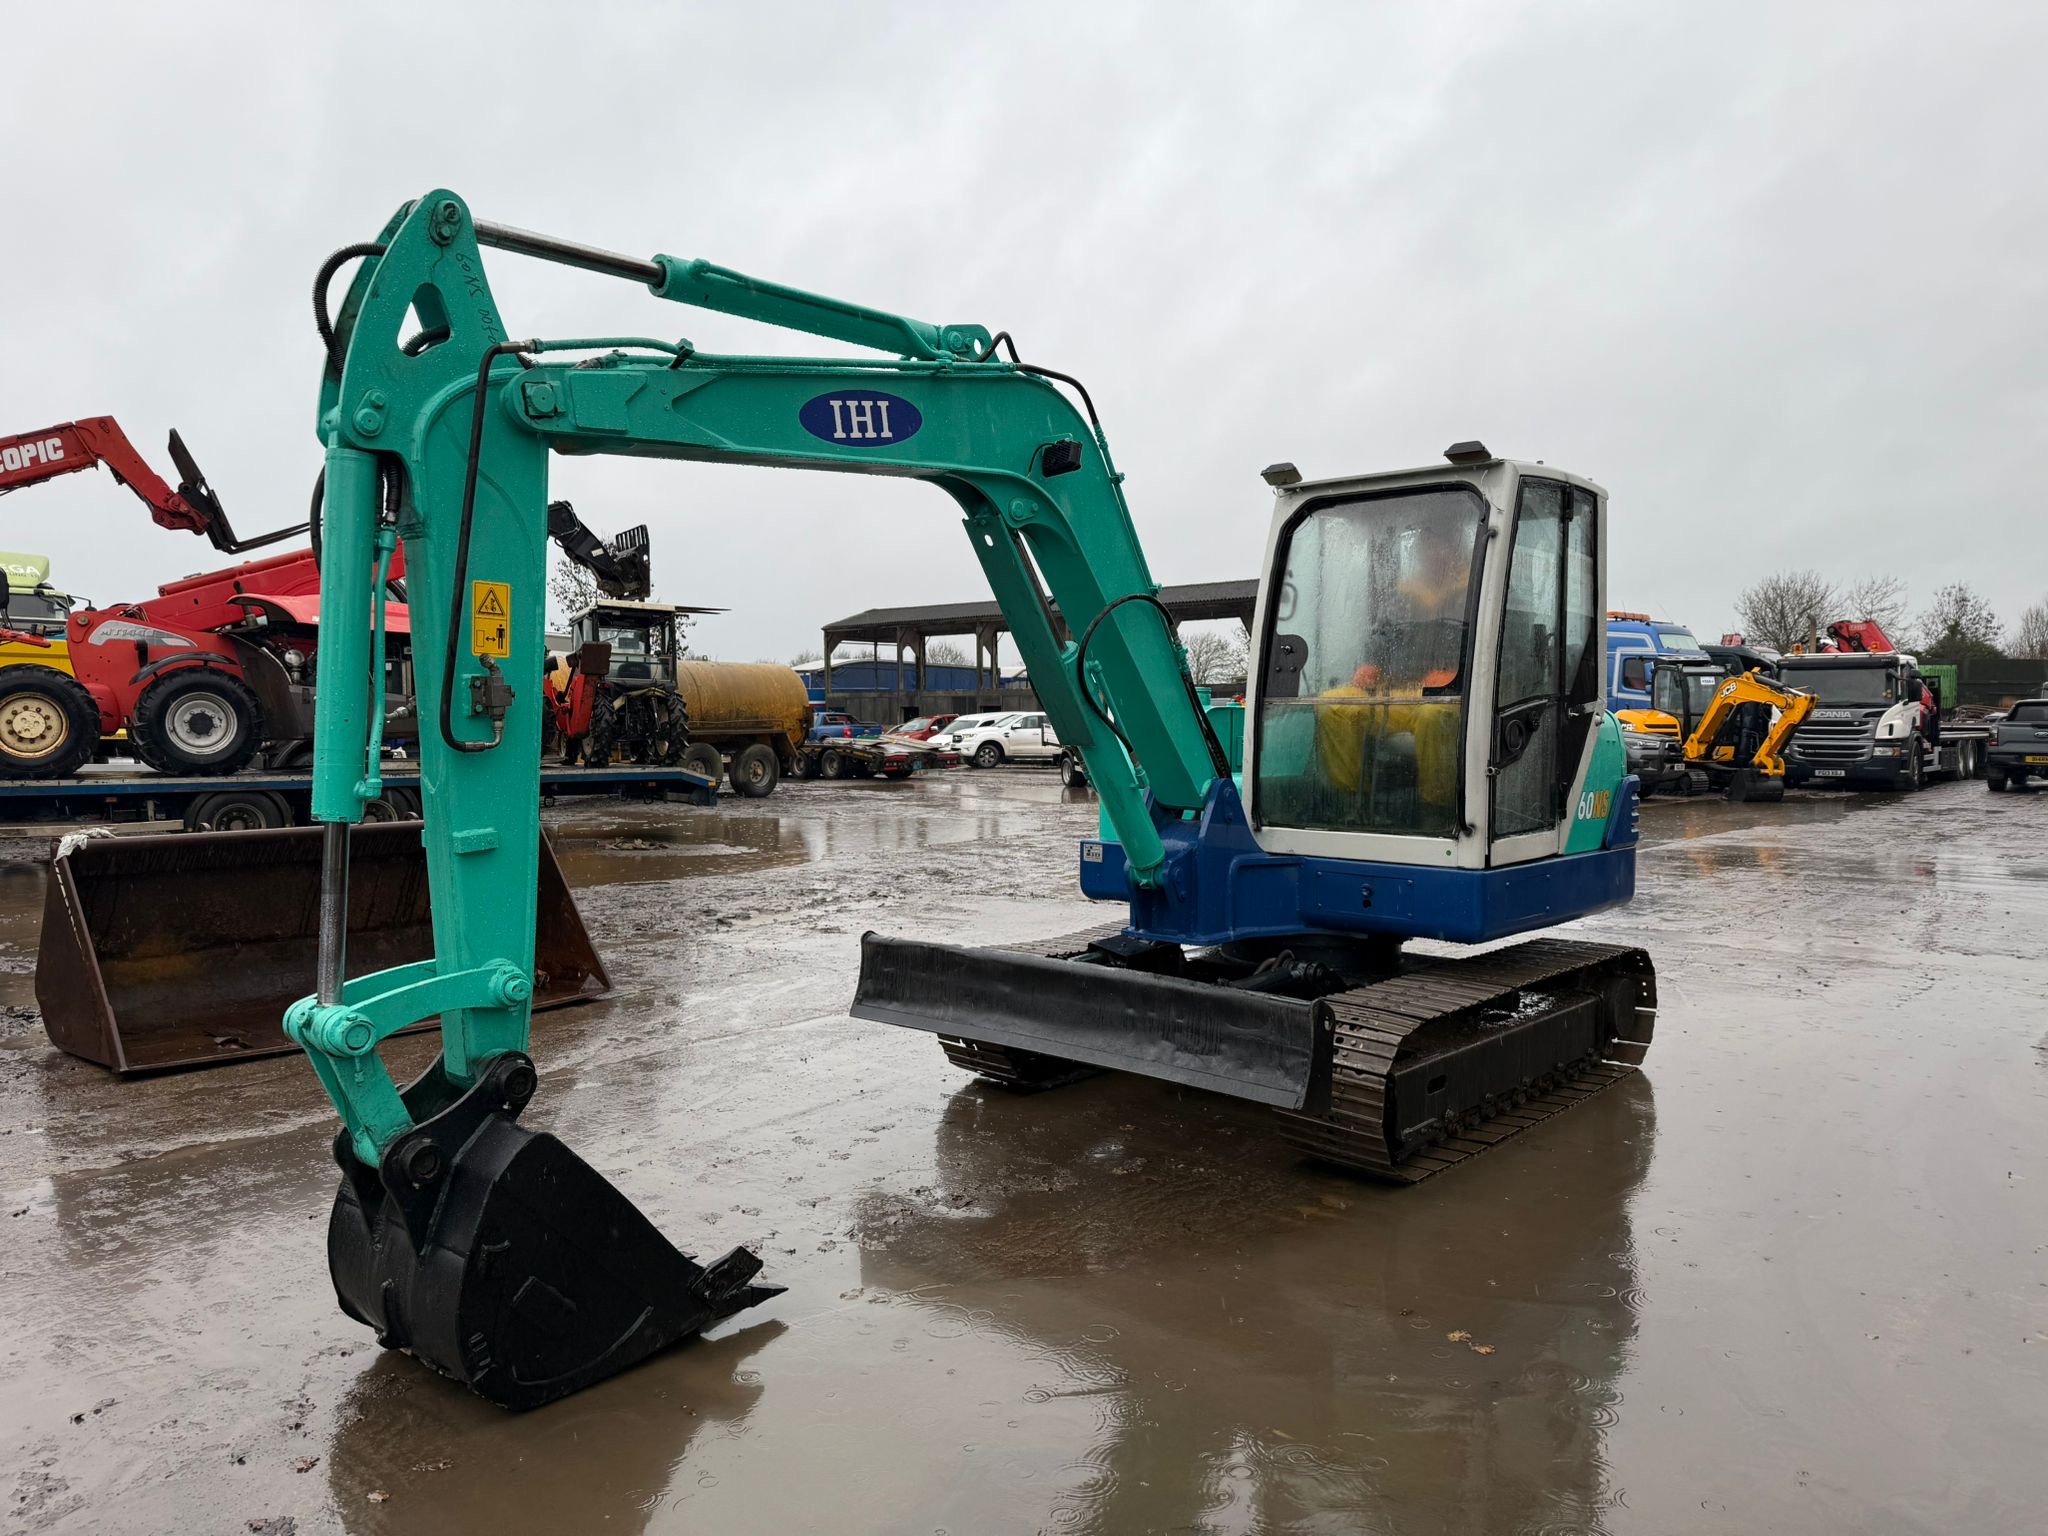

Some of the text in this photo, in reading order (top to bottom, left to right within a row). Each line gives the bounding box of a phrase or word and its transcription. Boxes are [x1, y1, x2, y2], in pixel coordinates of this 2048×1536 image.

[829, 400, 893, 439] IHI
[0, 437, 64, 474] OPIC
[1720, 681, 1738, 698] JCB
[1577, 789, 1610, 821] 60NS
